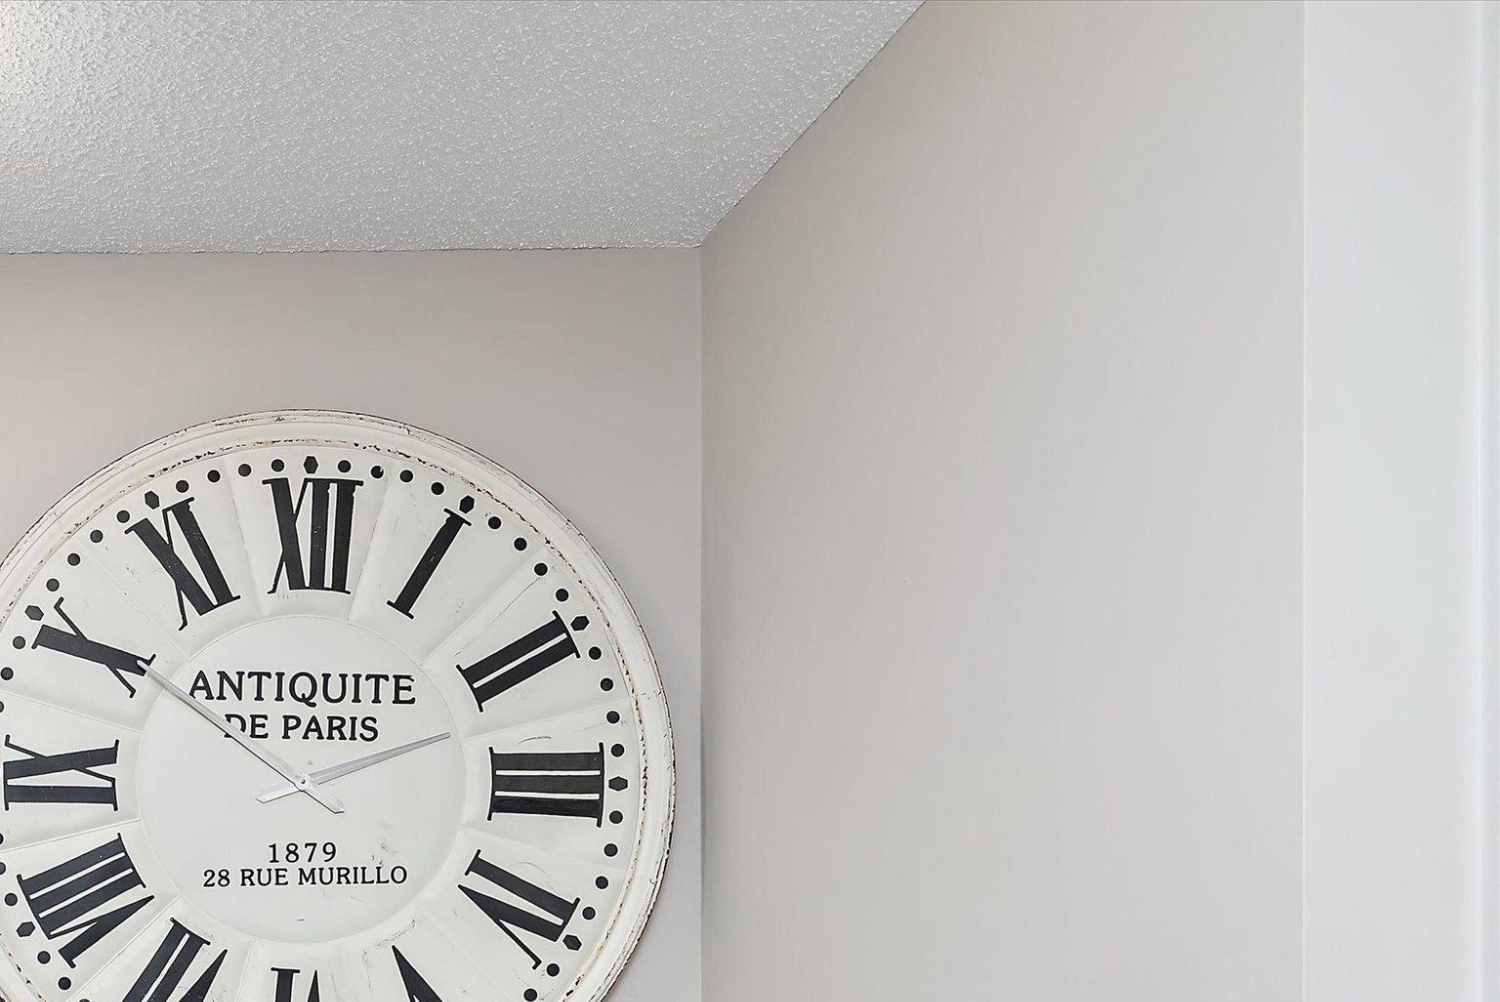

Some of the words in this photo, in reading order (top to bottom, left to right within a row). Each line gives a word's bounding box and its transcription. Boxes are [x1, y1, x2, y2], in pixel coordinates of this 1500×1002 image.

[123, 496, 241, 631] XI
[261, 477, 365, 595] XII
[386, 507, 472, 620] I
[30, 596, 157, 699] X
[188, 669, 416, 708] ANTIQUITE
[455, 610, 581, 713] II
[2, 734, 120, 812] IX
[223, 713, 269, 739] DE
[281, 714, 379, 742] PARIS
[486, 741, 605, 828] III
[16, 832, 155, 969] VIII
[203, 869, 231, 888] 28
[240, 868, 288, 887] RUE
[298, 865, 408, 886] MURILLO
[268, 842, 337, 864] 1879
[457, 848, 581, 971] IV
